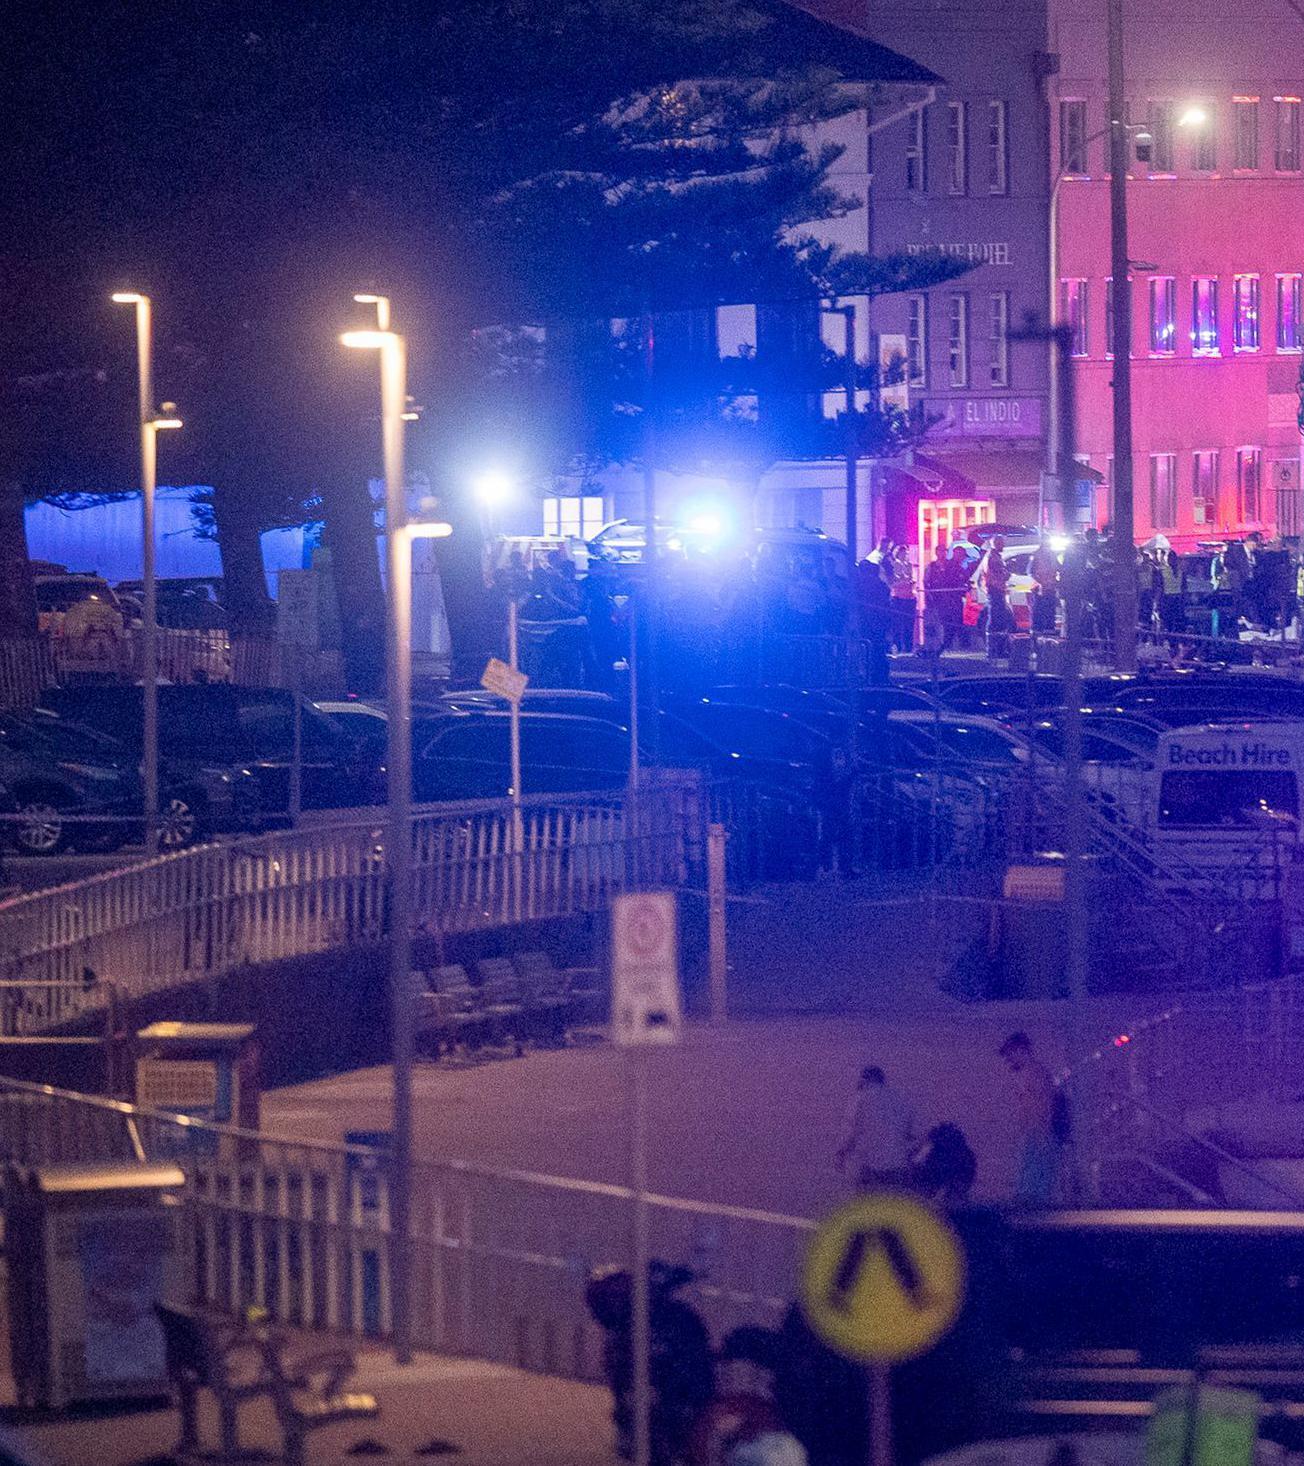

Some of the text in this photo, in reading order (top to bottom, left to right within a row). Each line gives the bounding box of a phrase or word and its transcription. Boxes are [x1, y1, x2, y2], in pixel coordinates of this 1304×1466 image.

[966, 402, 1020, 421] EL INDIO
[1169, 744, 1291, 765] Beach Hire
